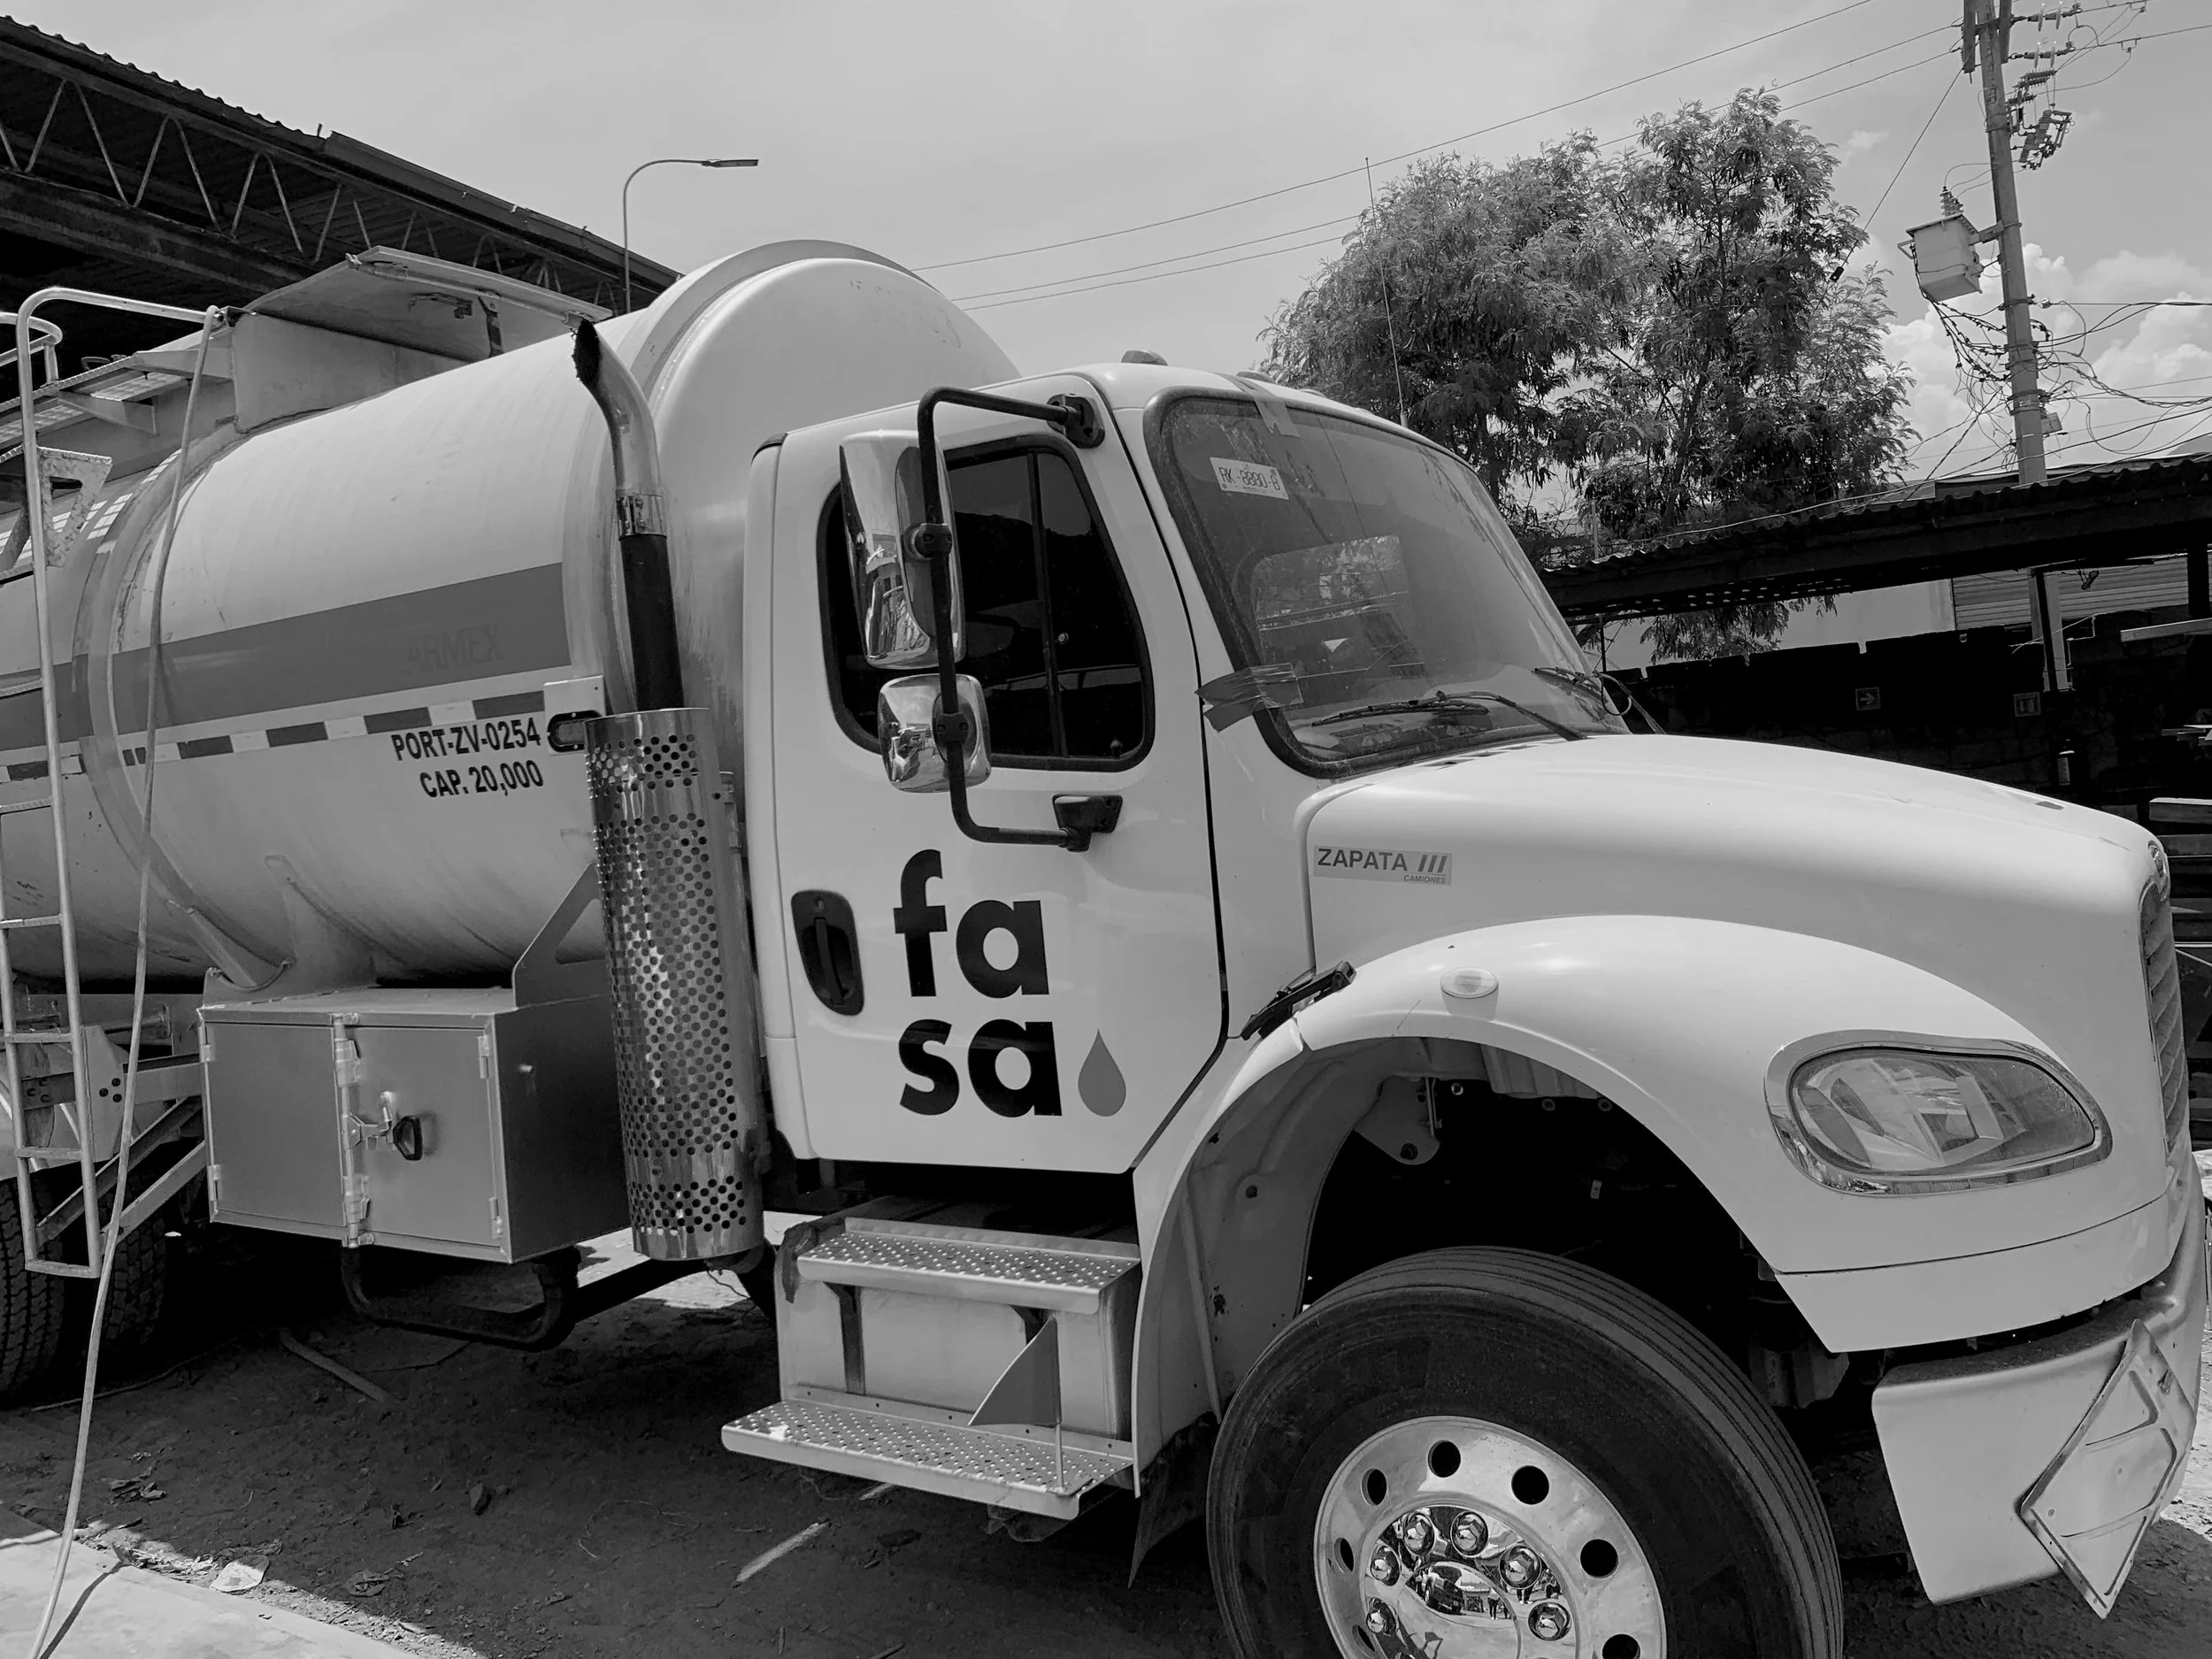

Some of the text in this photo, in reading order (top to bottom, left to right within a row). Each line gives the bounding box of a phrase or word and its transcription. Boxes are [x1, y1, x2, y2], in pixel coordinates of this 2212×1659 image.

[390, 717, 541, 762] PORT-ZV-0254
[419, 759, 544, 798] CAP. 20,000
[1317, 848, 1408, 872] ZAPATA
[1403, 874, 1446, 884] CAMIONES
[893, 849, 1049, 999] fa
[898, 1018, 1063, 1118] sa
